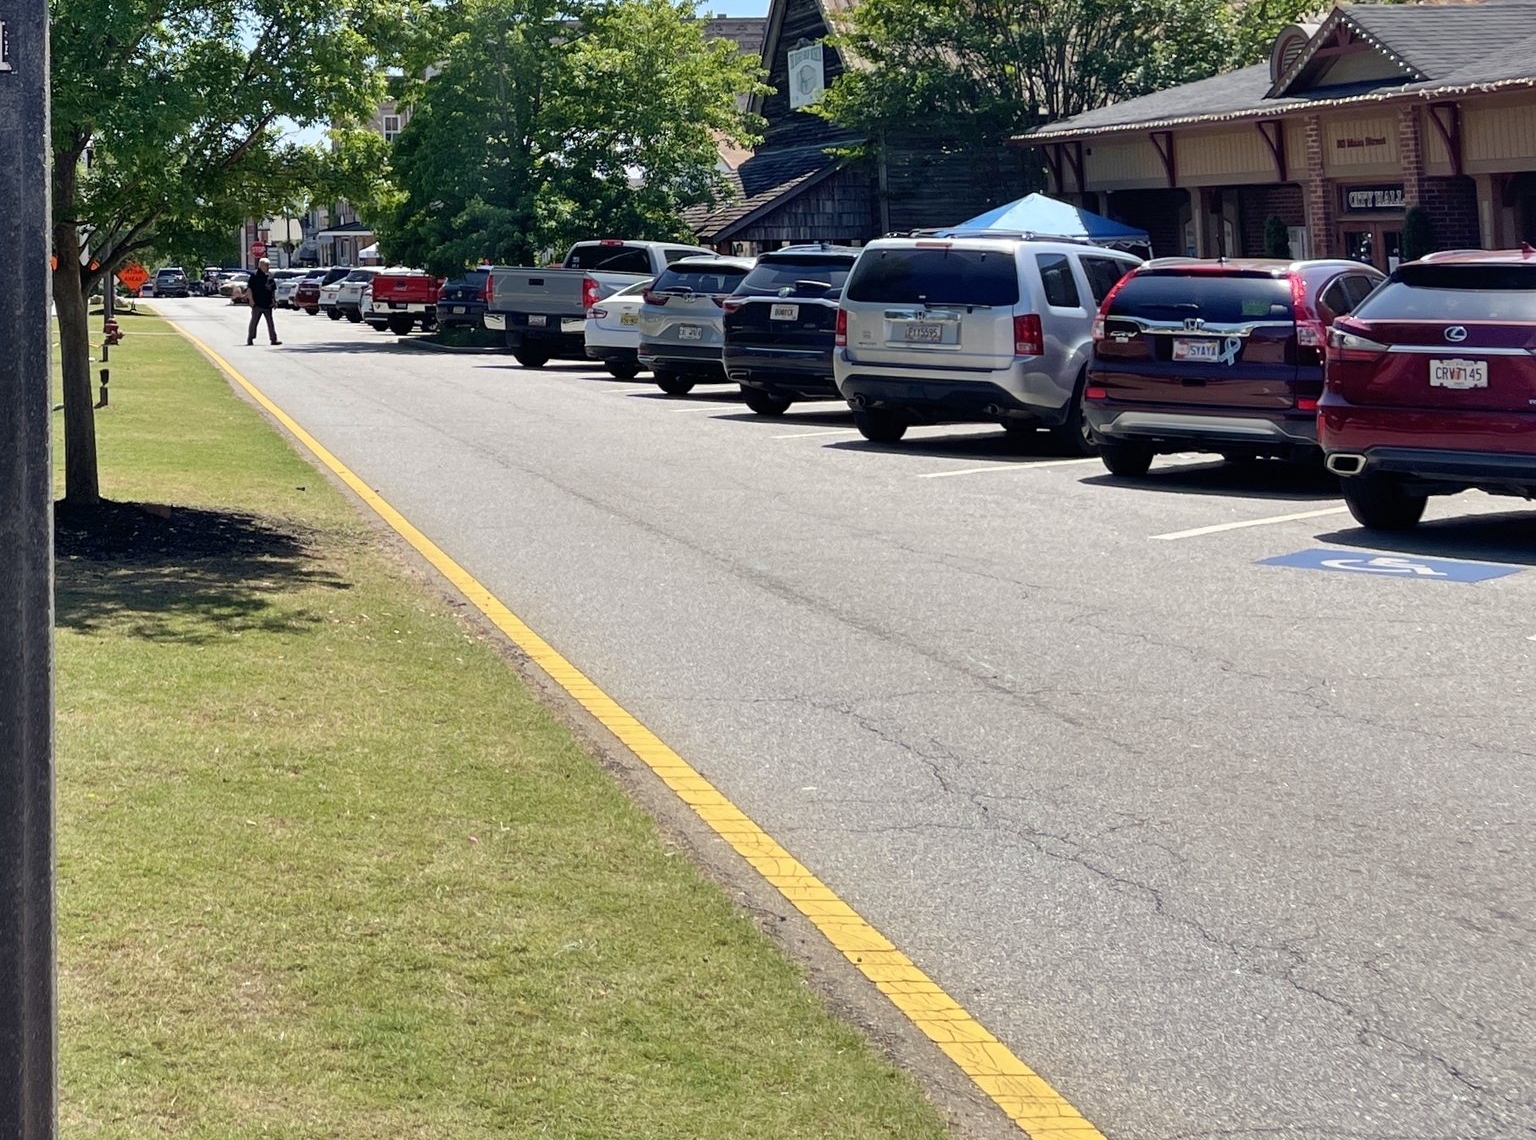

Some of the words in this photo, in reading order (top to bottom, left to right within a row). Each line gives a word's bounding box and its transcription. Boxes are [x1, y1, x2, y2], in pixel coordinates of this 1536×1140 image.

[1348, 190, 1374, 208] CITY
[1374, 189, 1406, 208] HALL
[251, 246, 266, 254] STOP
